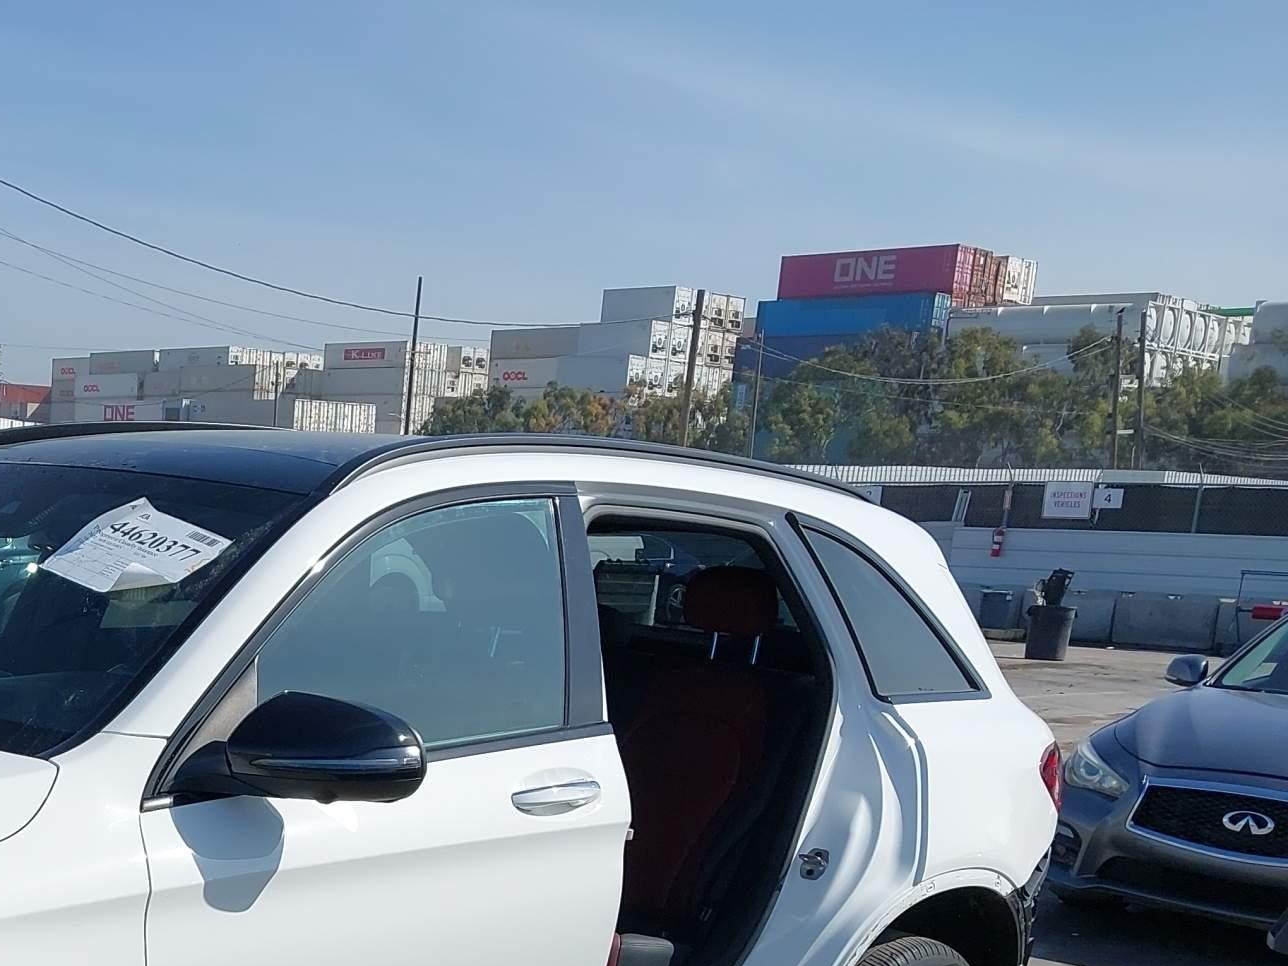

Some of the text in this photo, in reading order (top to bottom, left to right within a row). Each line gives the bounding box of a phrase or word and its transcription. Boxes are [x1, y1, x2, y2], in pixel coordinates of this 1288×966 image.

[833, 254, 897, 282] ONE
[503, 371, 528, 381] OOCL
[103, 404, 135, 421] ONE
[1104, 493, 1112, 504] 4
[109, 521, 201, 562] 44620377
